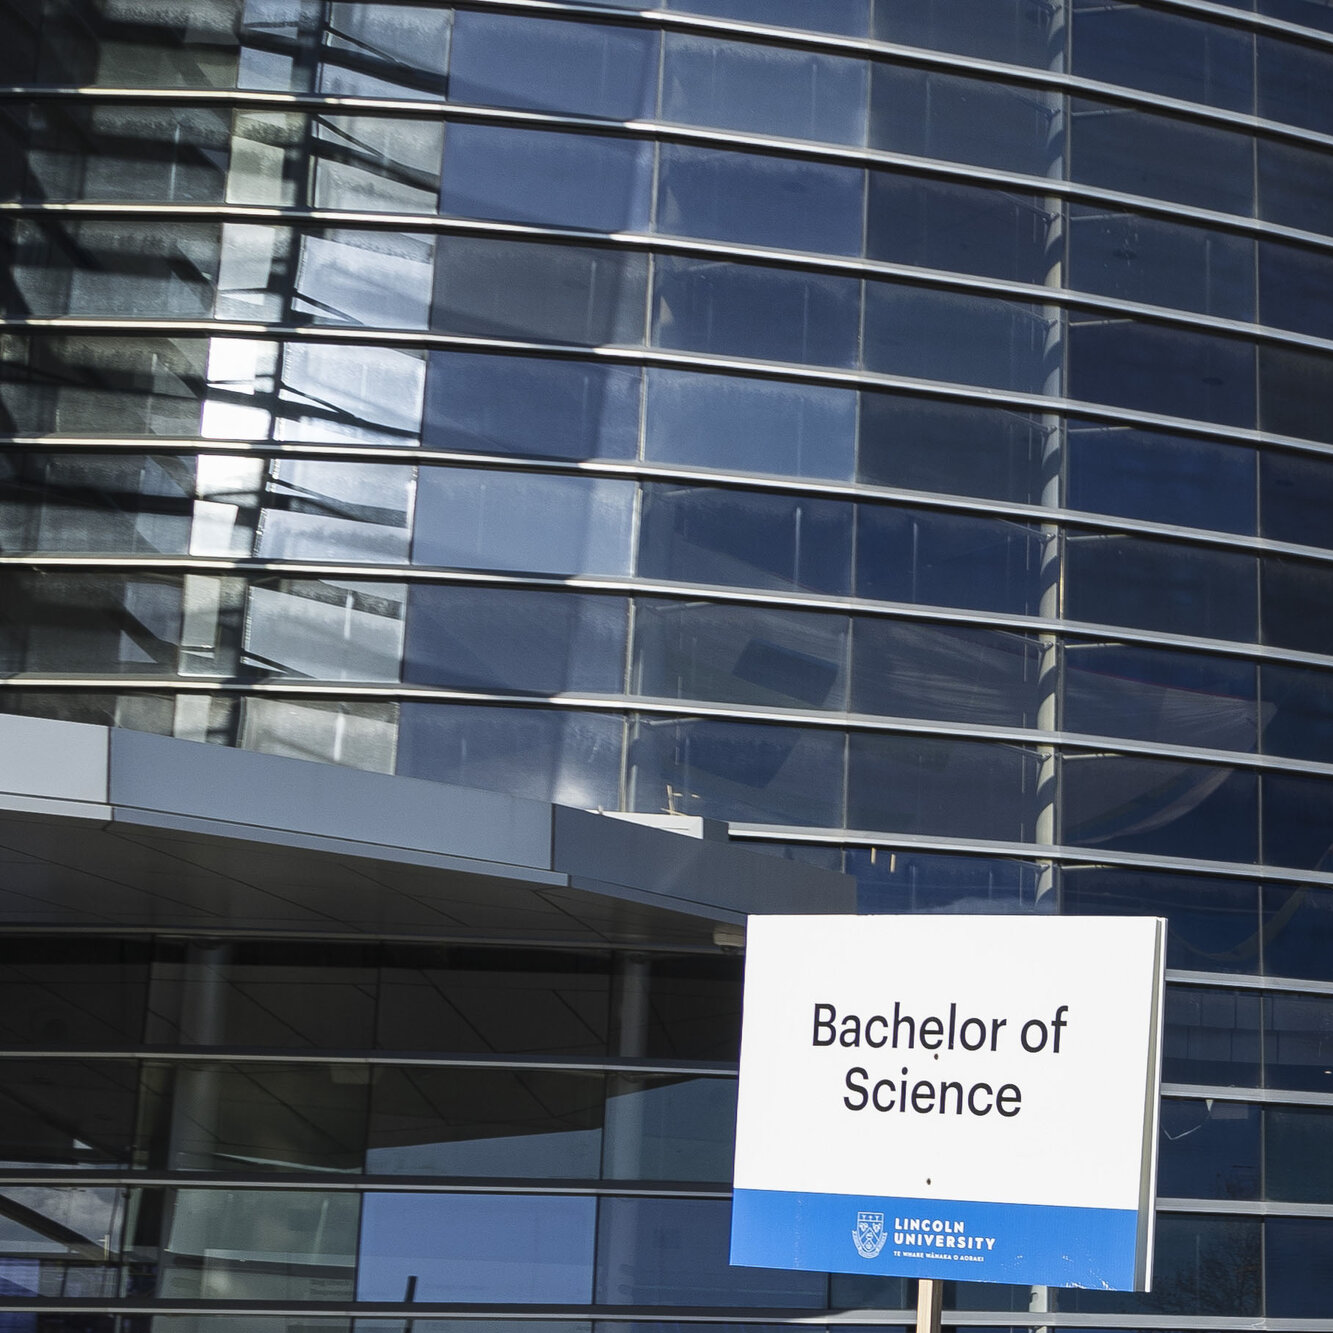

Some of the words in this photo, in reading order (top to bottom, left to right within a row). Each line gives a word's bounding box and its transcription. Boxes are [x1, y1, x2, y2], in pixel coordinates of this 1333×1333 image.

[812, 1001, 1007, 1052] Bachelor
[1020, 1005, 1069, 1054] of
[843, 1066, 1022, 1118] Science
[894, 1232, 996, 1250] UNIVERSITY
[895, 1217, 964, 1234] LINCOLN
